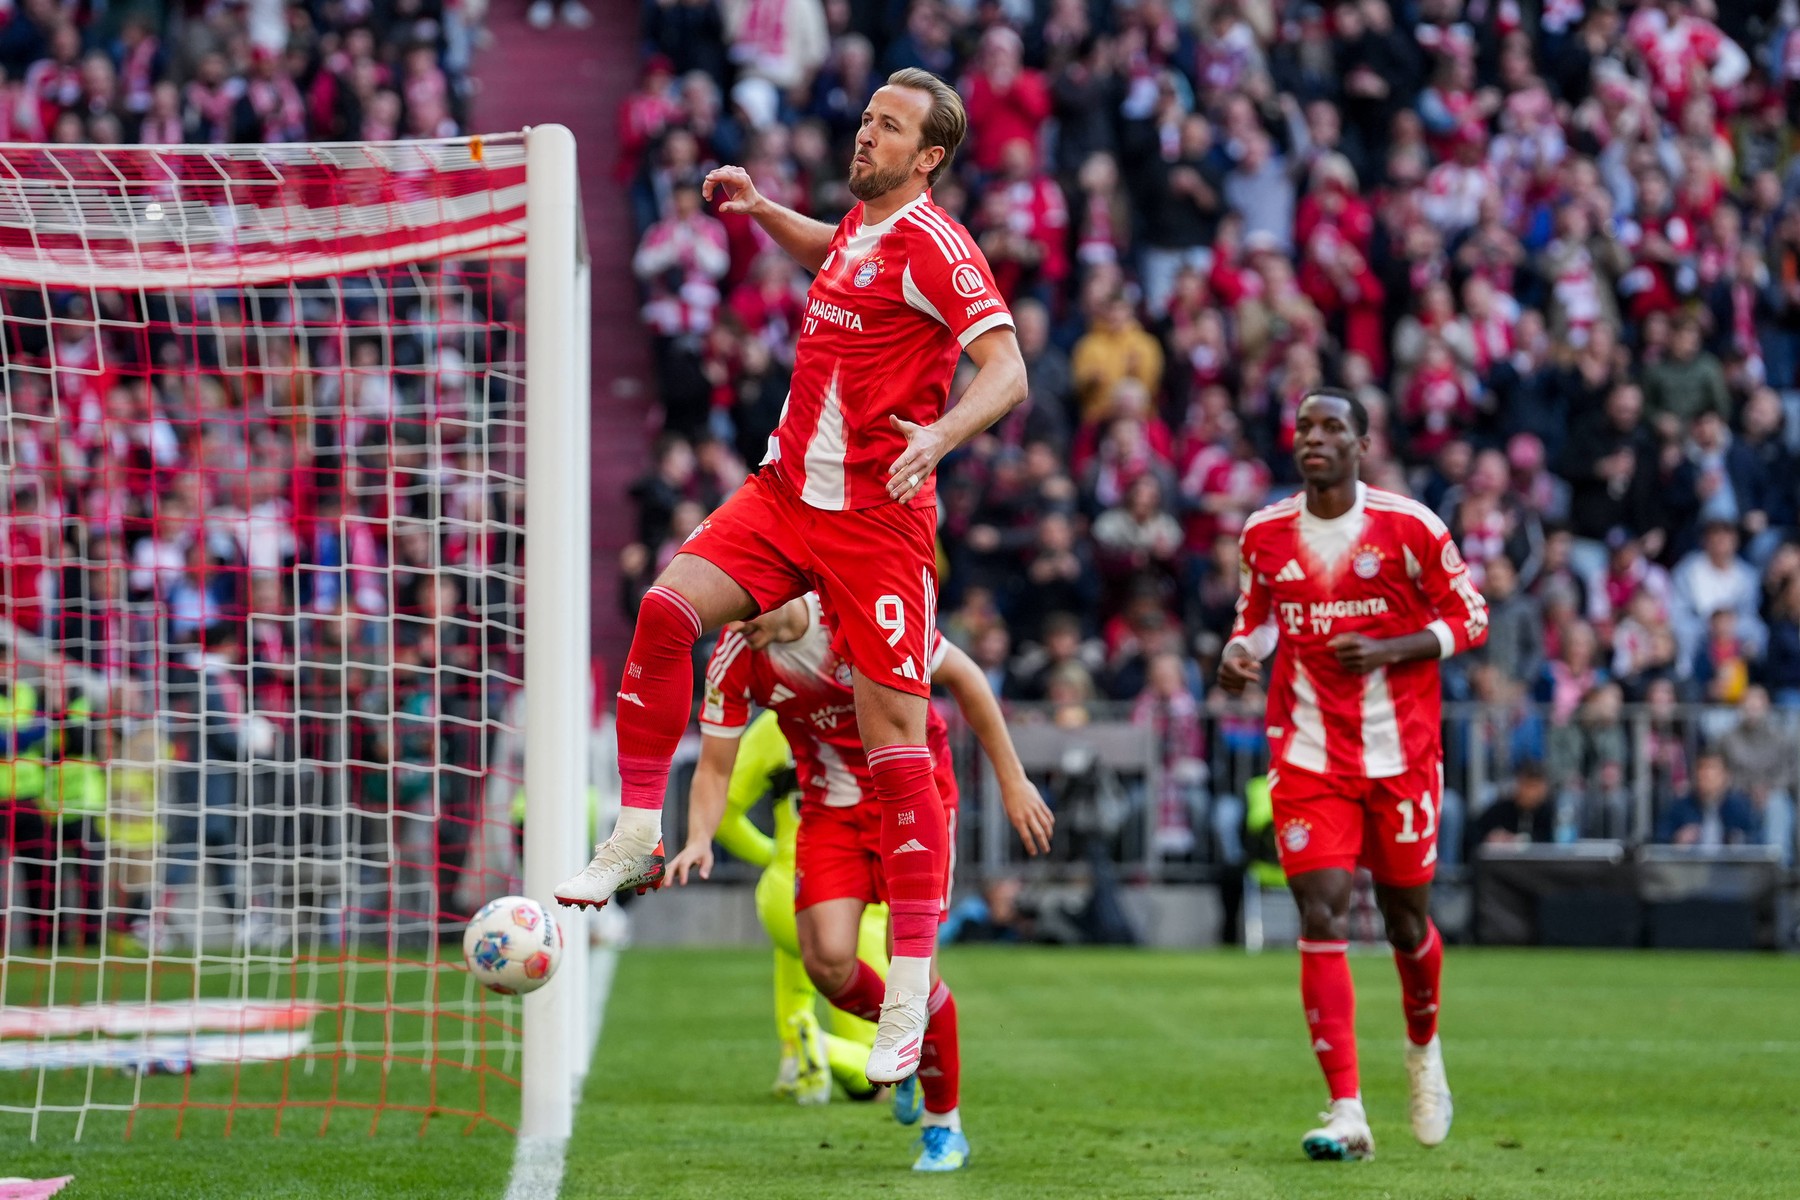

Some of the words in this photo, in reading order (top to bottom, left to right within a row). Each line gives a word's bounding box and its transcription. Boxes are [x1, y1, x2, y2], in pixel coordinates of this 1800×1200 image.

[809, 298, 863, 332] MAGENTA
[803, 316, 819, 336] TV
[1310, 597, 1389, 618] MAGENTA
[875, 594, 905, 648] 9
[1310, 618, 1333, 635] TV
[814, 714, 838, 731] TV
[1395, 790, 1436, 843] 11
